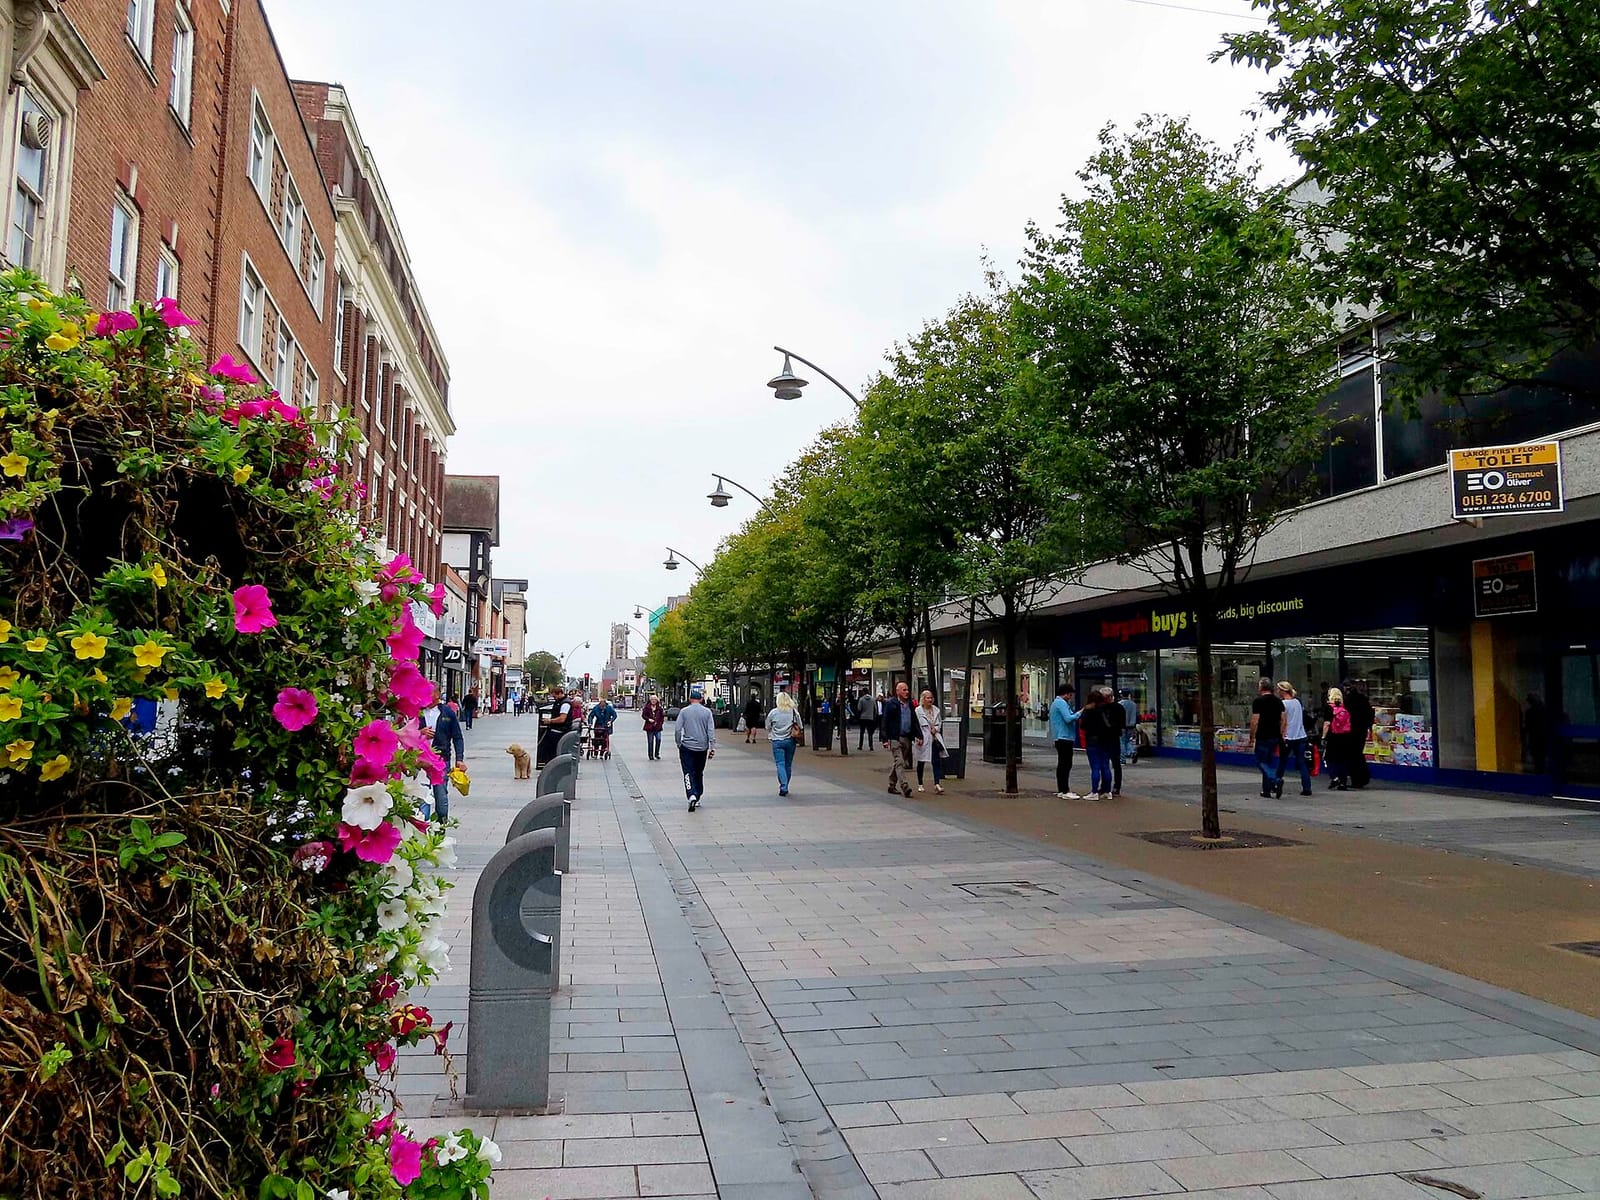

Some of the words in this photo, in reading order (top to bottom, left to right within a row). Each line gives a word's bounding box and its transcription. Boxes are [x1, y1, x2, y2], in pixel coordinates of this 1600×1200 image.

[1475, 456, 1499, 467] TO
[1501, 453, 1533, 465] LET
[1506, 470, 1544, 478] Emanuel
[1506, 478, 1532, 486] Oliver
[1462, 494, 1487, 506] 0151
[1491, 493, 1515, 505] 236
[1518, 490, 1552, 502] 6700
[1240, 603, 1255, 618] big
[1257, 597, 1304, 615] discounts
[1101, 612, 1149, 643] bargain
[1151, 609, 1187, 638] buys
[445, 649, 461, 660] JD
[976, 638, 999, 656] Clarks
